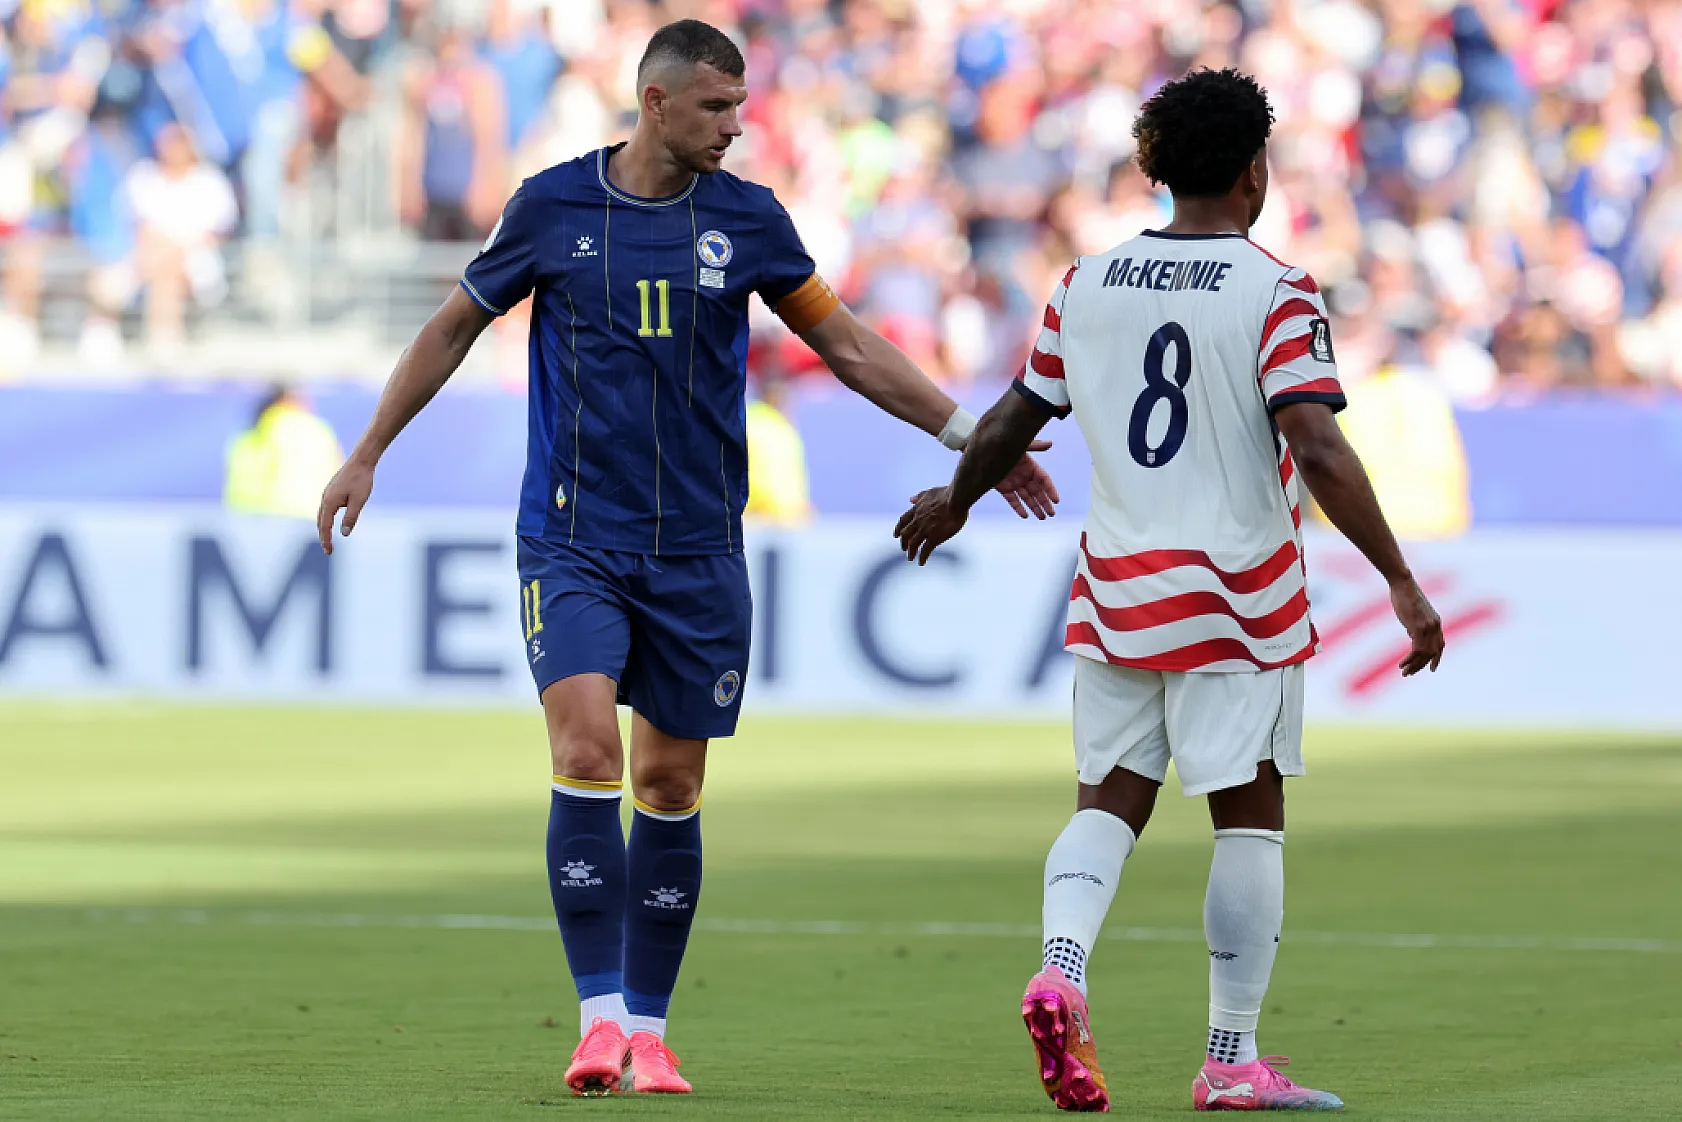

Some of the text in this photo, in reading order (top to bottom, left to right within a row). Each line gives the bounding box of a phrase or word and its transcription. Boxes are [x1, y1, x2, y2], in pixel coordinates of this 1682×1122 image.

[1103, 258, 1232, 291] McKENNIE
[636, 279, 673, 337] 11
[1128, 321, 1191, 469] 8
[523, 579, 544, 641] 11
